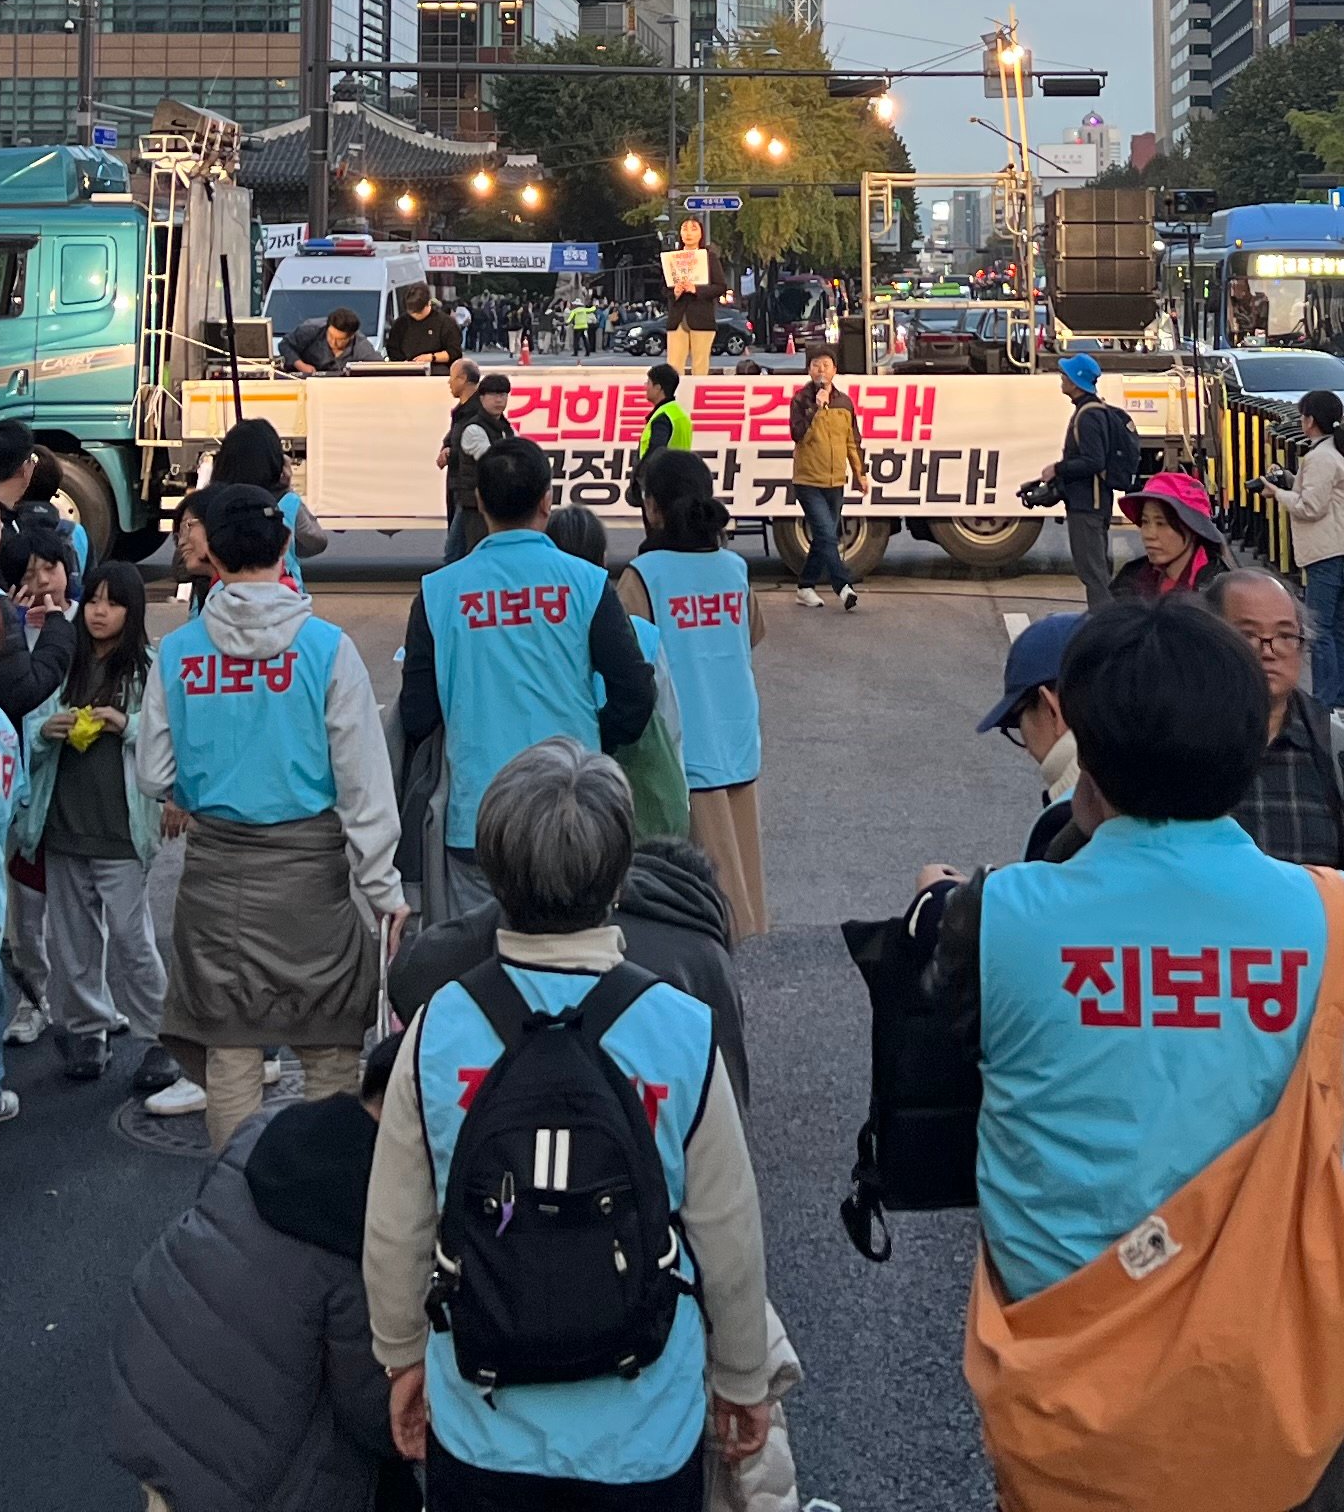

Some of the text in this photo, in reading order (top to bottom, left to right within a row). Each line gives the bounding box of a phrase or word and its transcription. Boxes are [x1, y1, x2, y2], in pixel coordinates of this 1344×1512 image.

[301, 275, 352, 285] POLICE
[40, 354, 96, 372] CARRY
[690, 384, 936, 442] 특검라!
[461, 586, 570, 628] 진보당
[668, 591, 745, 629] 진보당
[180, 651, 299, 695] 진보당
[1060, 945, 1309, 1034] 진보당
